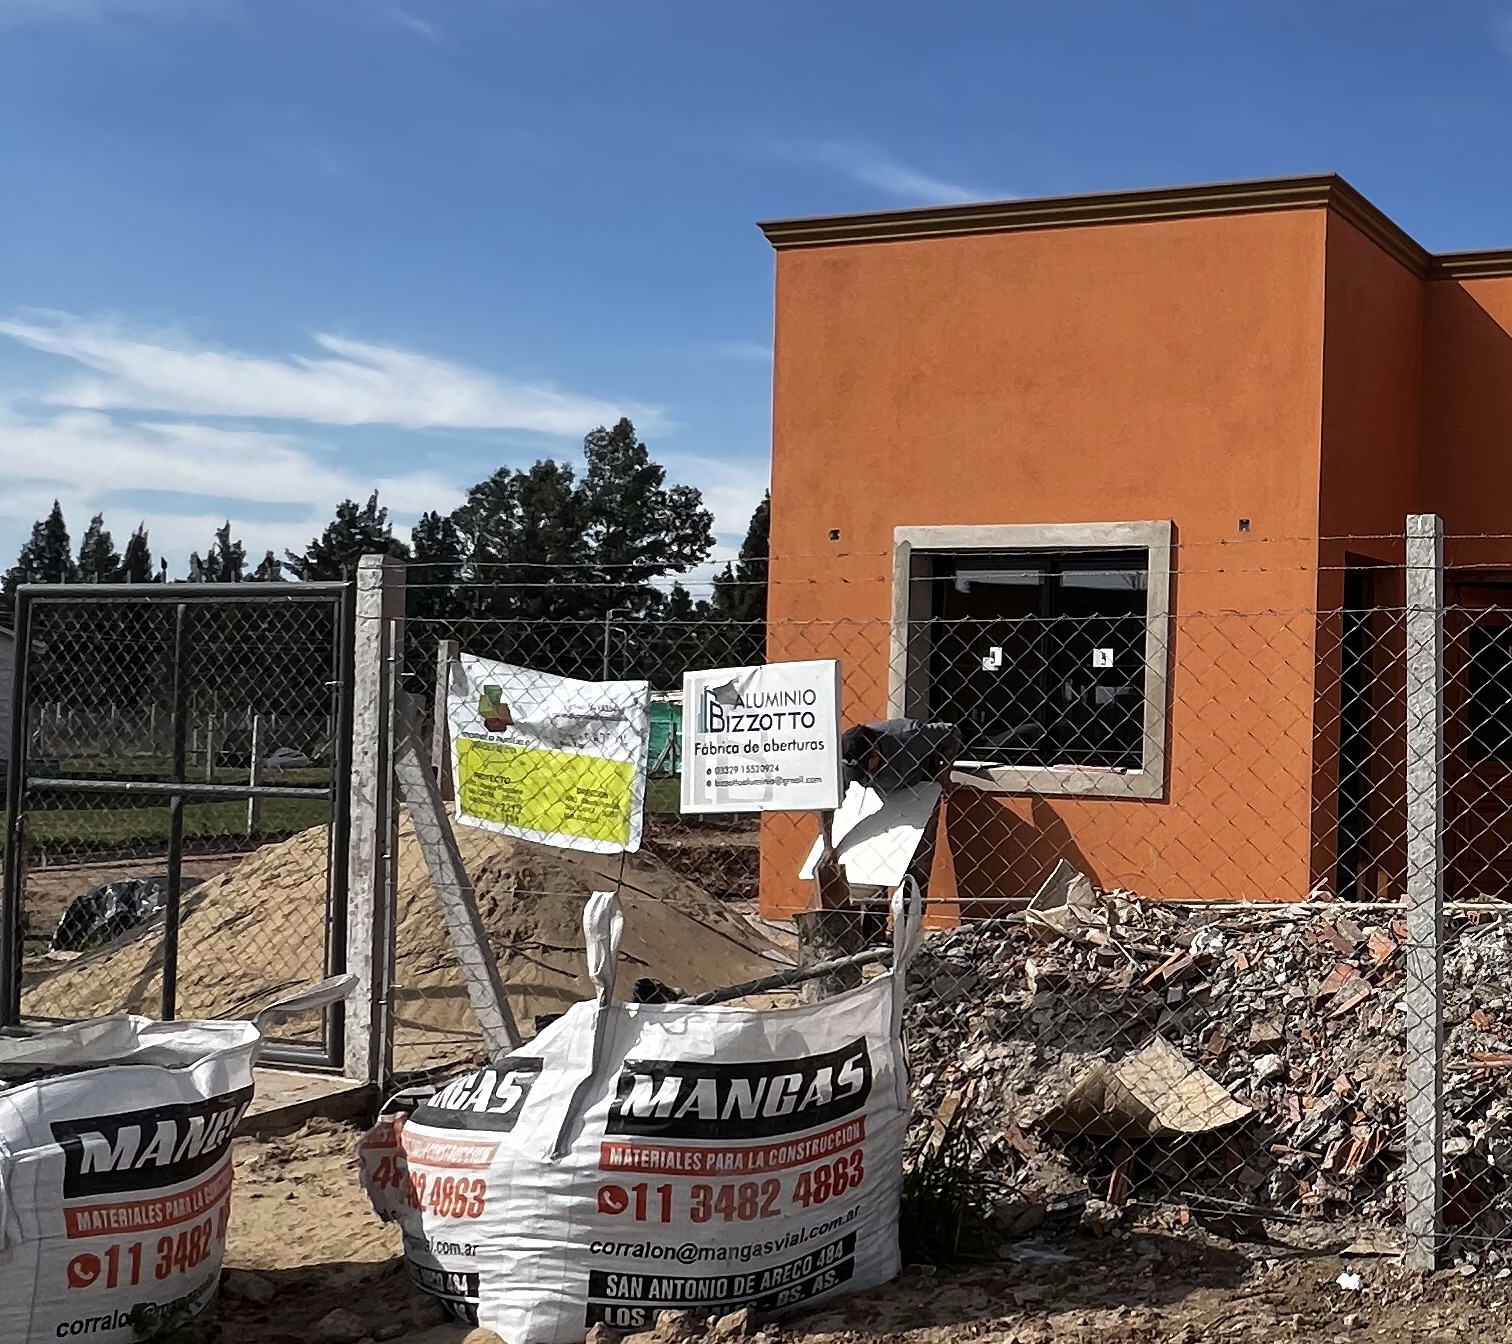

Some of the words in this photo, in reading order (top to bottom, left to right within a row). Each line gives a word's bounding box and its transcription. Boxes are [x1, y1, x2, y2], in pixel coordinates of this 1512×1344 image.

[709, 700, 816, 734] BIZZOTTO
[733, 689, 817, 710] ALUMINIO
[694, 741, 739, 756] Fábrica
[743, 739, 760, 754] de
[763, 738, 825, 753] aberturas
[619, 1052, 864, 1121] MANGAS
[608, 1146, 702, 1171] MATERIALES
[706, 1152, 744, 1170] PARA
[747, 1151, 765, 1169] LA
[75, 1203, 163, 1232] MATERIALES
[429, 1175, 487, 1219] 4863
[631, 1182, 673, 1223] 11
[690, 1178, 782, 1224] 3482
[104, 1241, 142, 1290] 11
[154, 1217, 213, 1281] 3482
[589, 1205, 861, 1265] corralon@mangasvial.com.ar
[606, 1274, 643, 1298] SAN
[648, 1278, 728, 1300] ANTONIO
[733, 1276, 755, 1297] DE
[760, 1257, 813, 1291] ARECO
[816, 1240, 845, 1268] 484
[604, 1306, 645, 1327] LOS
[811, 1269, 841, 1293] AS.
